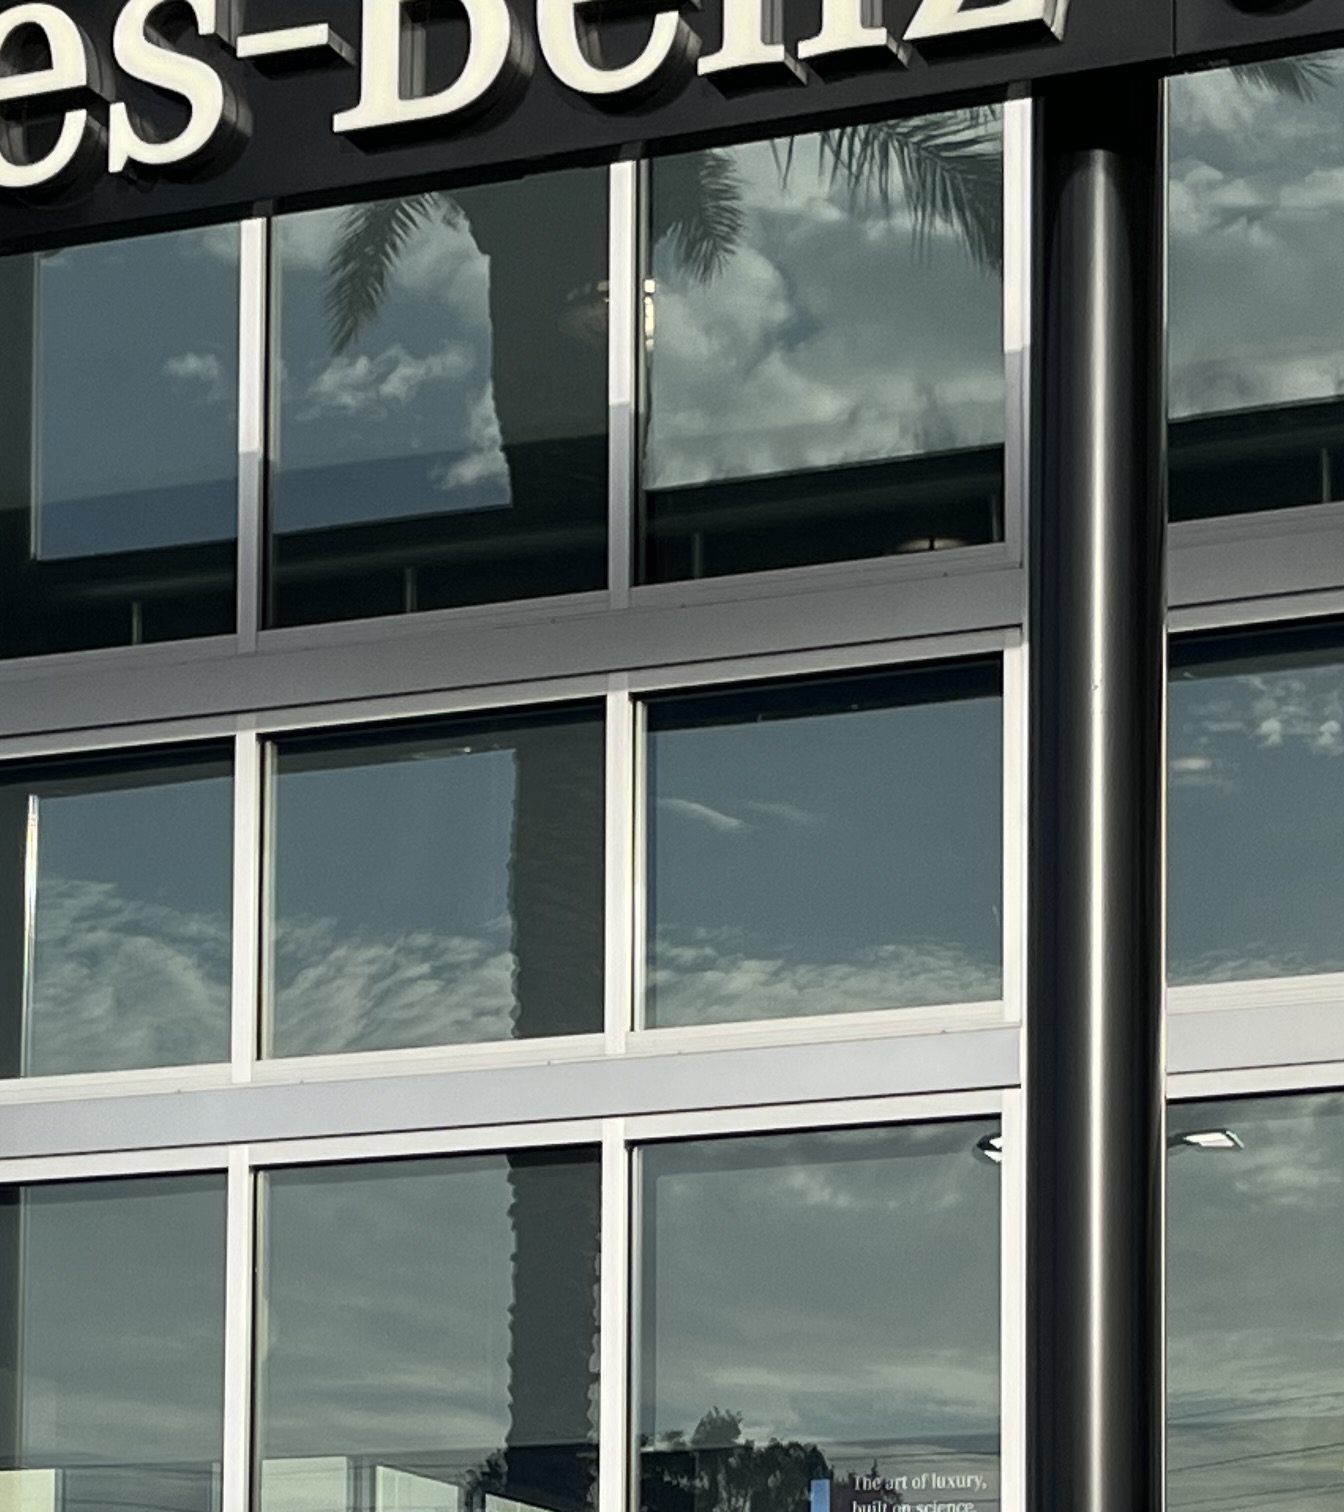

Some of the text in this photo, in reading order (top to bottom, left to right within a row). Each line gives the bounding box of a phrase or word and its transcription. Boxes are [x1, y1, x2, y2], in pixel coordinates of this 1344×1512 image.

[854, 1472, 987, 1492] The art of luxury,
